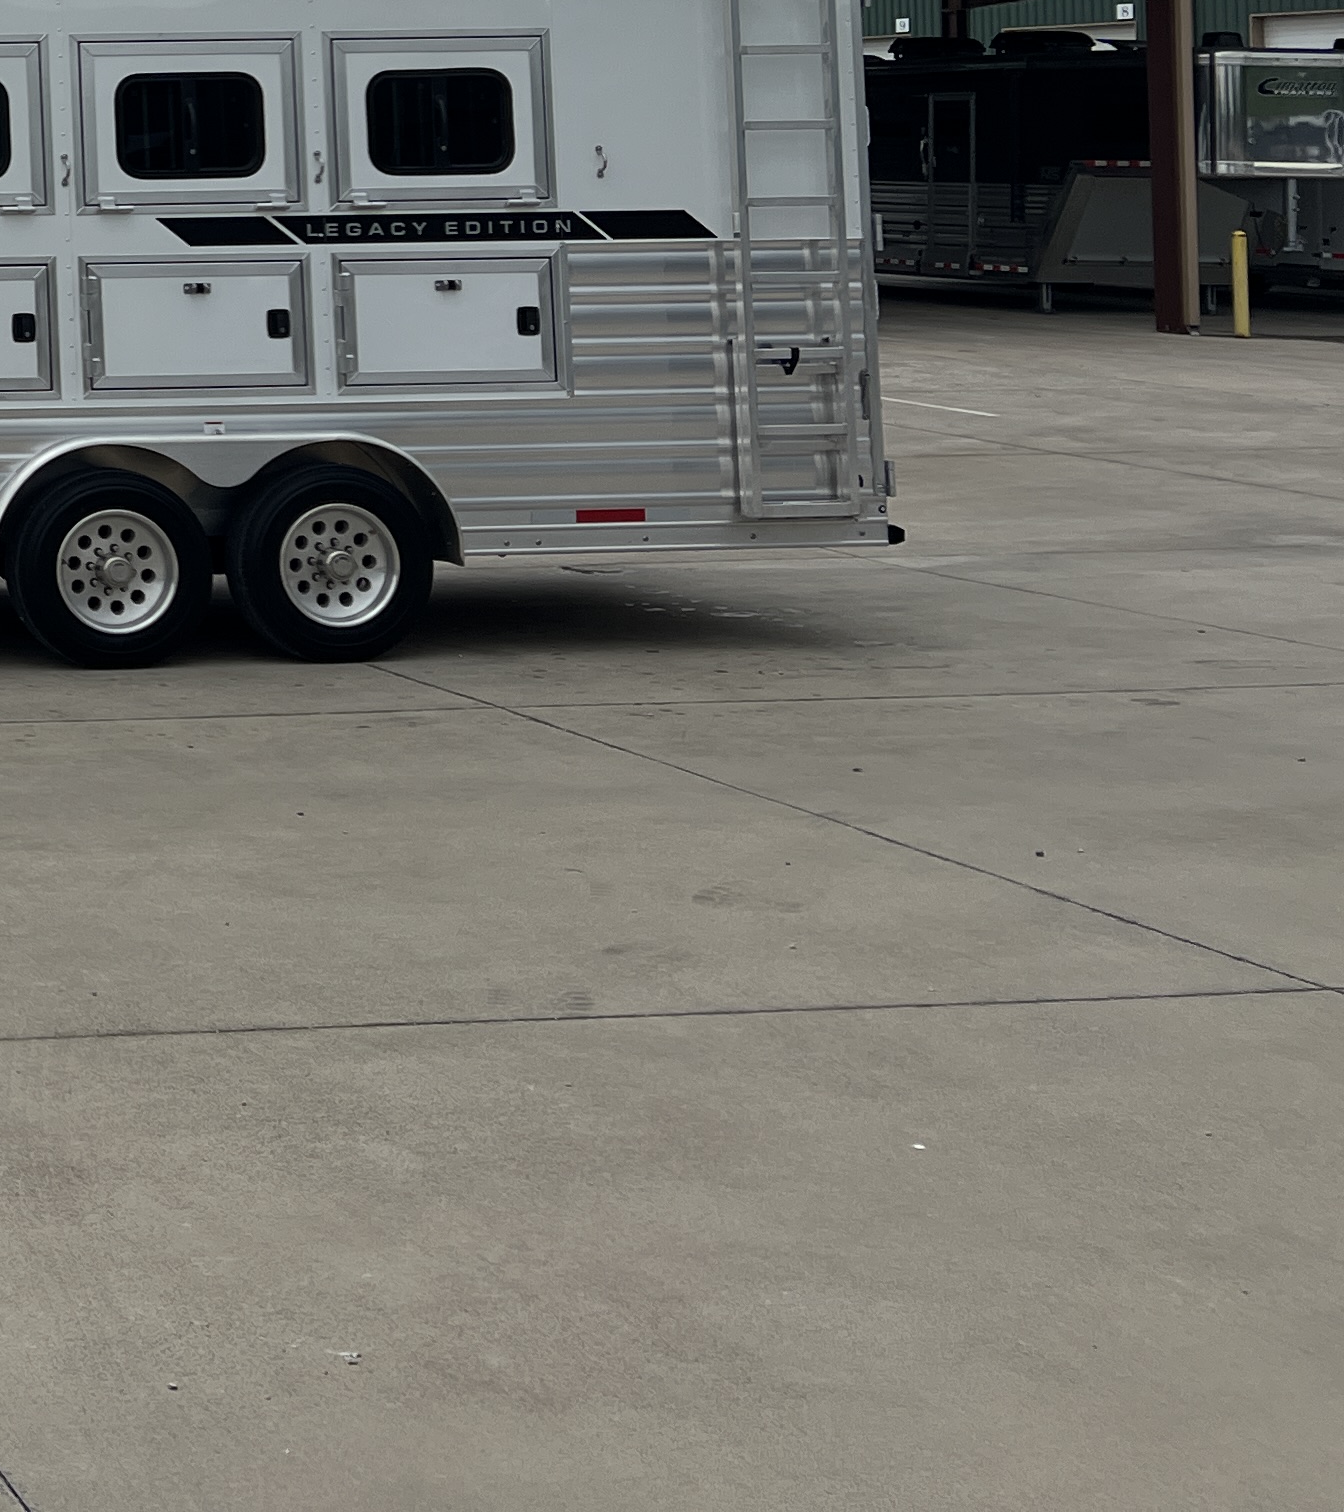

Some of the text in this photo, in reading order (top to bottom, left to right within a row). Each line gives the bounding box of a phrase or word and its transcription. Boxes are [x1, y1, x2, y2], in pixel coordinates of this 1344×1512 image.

[1121, 5, 1130, 18] 8
[898, 20, 906, 31] 9
[306, 219, 572, 237] LEGACY EDITION
